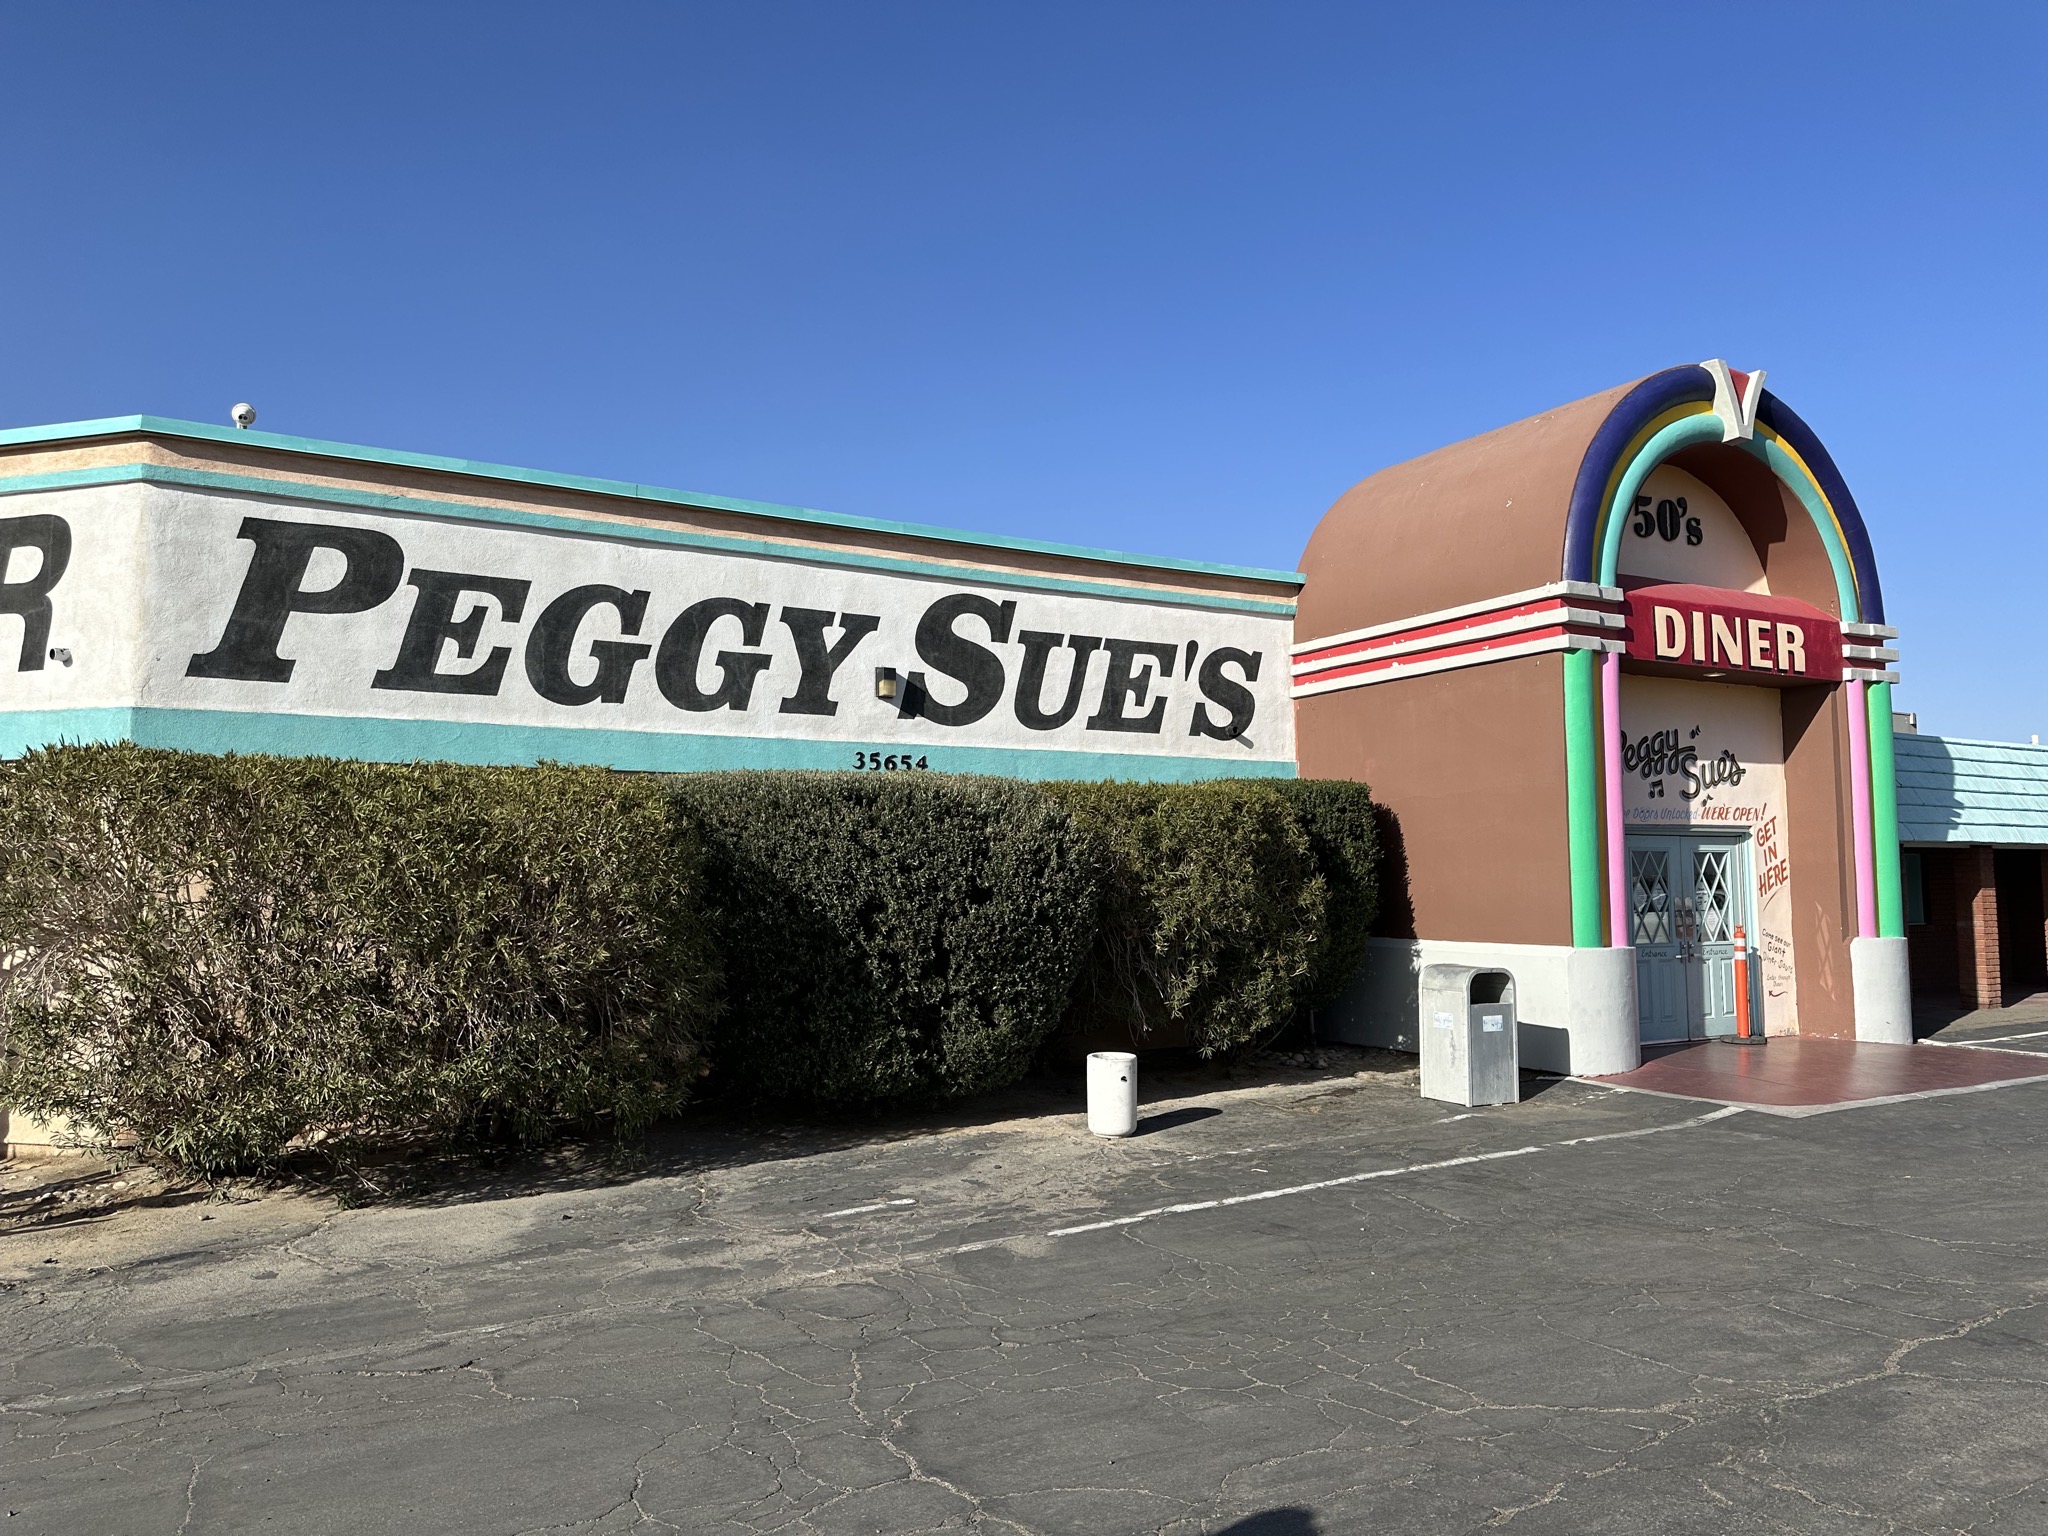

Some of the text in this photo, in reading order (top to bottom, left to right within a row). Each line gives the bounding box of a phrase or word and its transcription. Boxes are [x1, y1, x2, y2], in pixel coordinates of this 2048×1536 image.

[1633, 495, 1704, 547] 50's
[184, 516, 1263, 743] PEGGY SUE'S
[1653, 604, 1807, 675] DINER
[852, 751, 929, 771] 35654
[1680, 748, 1747, 800] Sue's
[1732, 802, 1767, 821] OPEN!
[1756, 815, 1777, 848] GET
[1763, 841, 1778, 867] IN
[1758, 858, 1789, 898] HERE
[1762, 928, 1775, 940] Come
[1641, 948, 1668, 958] Entrance
[1702, 946, 1728, 956] Entrance
[1767, 941, 1786, 958] Giant
